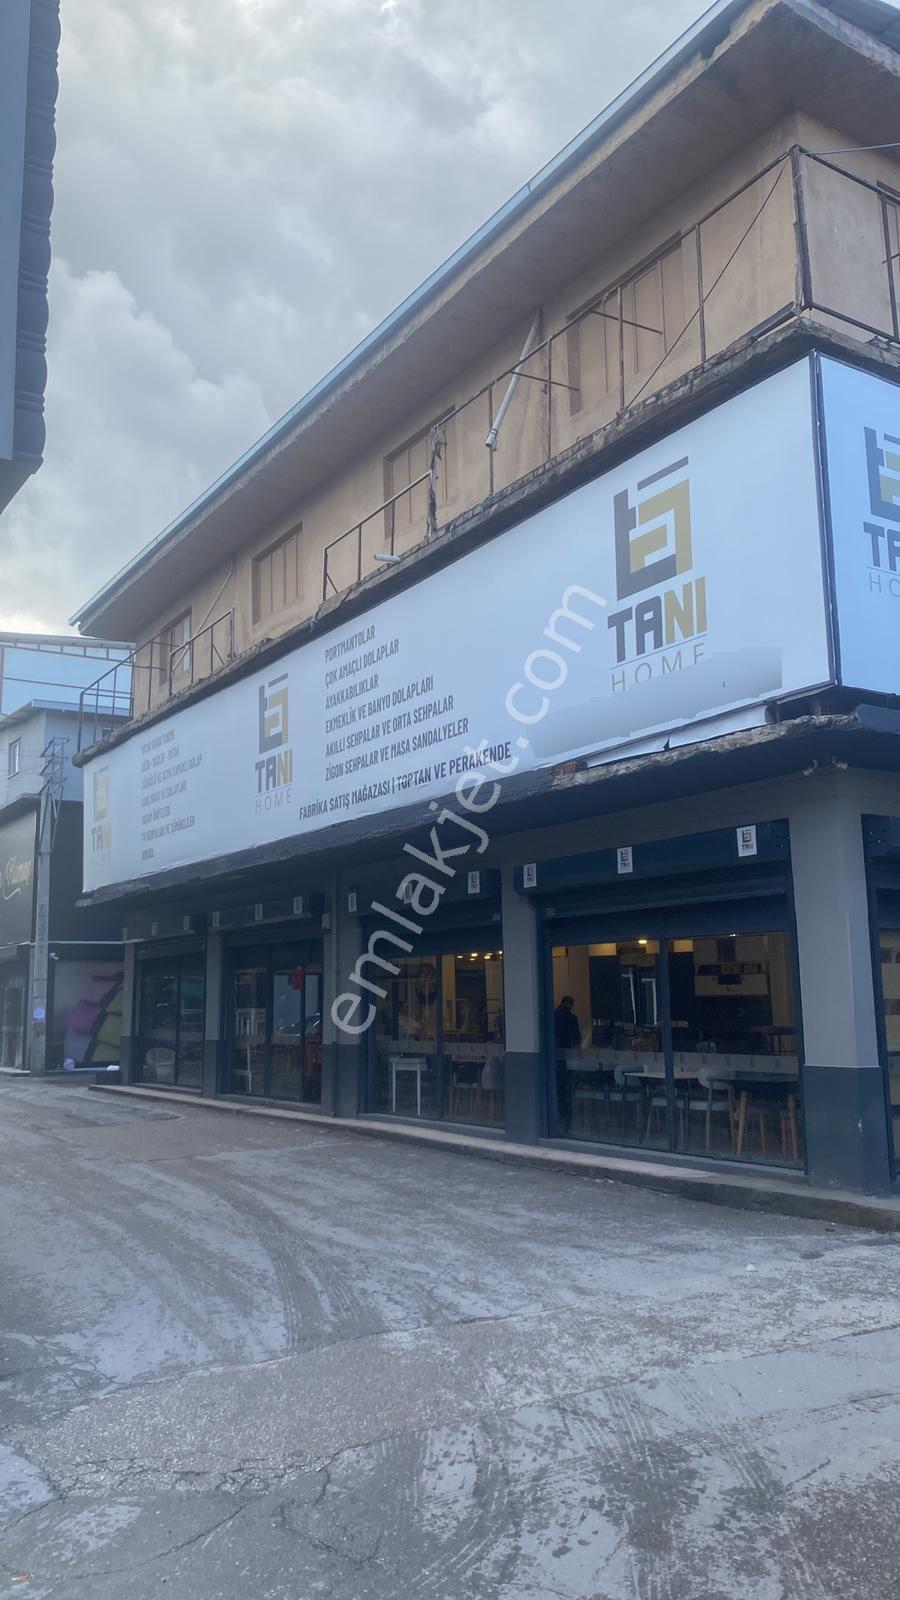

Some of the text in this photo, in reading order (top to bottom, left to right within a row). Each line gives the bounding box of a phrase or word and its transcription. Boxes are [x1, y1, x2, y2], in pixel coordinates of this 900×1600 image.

[325, 625, 375, 664] PORTMANTOLAR
[607, 576, 707, 663] TANI
[325, 638, 399, 689] ÇOK AMAÇLI DOLAPLAR
[325, 674, 379, 711] AYAKKABILIKLAR
[325, 675, 434, 734] EKMEKLİK VE BANYO DOLAPLARI
[325, 694, 454, 758] AKILLI SEHPALAR VE ORTA SEHPALAR
[325, 717, 469, 781] ZİGON SEHPALAR VE MASA SANDALYELER
[255, 748, 293, 794] TANI
[299, 741, 512, 822] FABRİKA SATIŞ MAĞAZASI TOPTAN VE PERAKENDE
[255, 788, 293, 813] HOME
